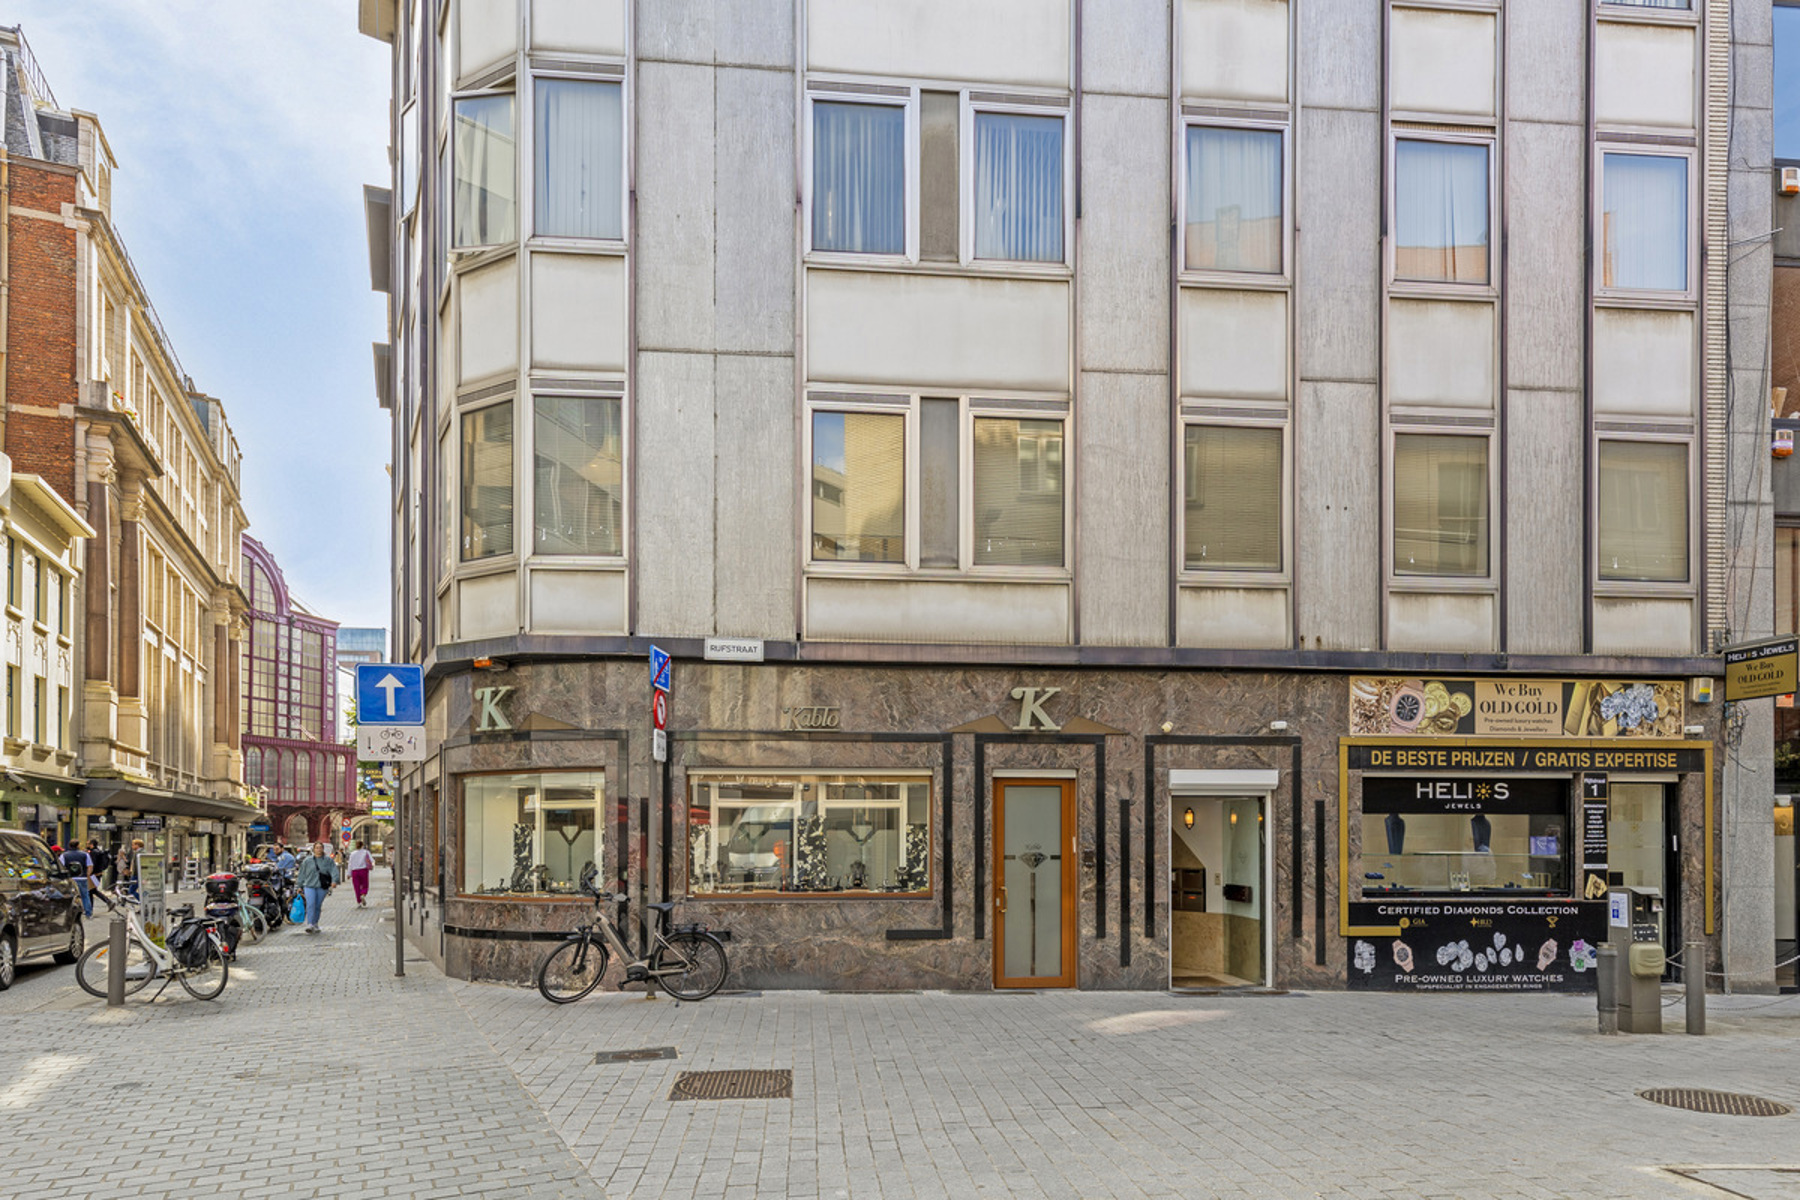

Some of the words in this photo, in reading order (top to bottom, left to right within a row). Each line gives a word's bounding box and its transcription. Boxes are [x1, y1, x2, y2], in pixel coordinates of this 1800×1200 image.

[1737, 674, 1756, 684] OLD
[1757, 670, 1784, 681] GOLD
[1494, 683, 1516, 696] We
[1519, 683, 1544, 700] Buy
[474, 685, 515, 731] K
[1011, 687, 1061, 730] K
[1480, 701, 1512, 714] OLD
[1514, 701, 1558, 714] GOLD
[782, 706, 841, 731] Kablo
[1371, 750, 1392, 765] DE
[1396, 750, 1447, 766] BESTE
[1451, 751, 1515, 766] PRIJZEN
[1535, 752, 1591, 767] GRATIS
[1595, 752, 1678, 768] EXPERTISE
[1591, 784, 1598, 796] 1
[1378, 905, 1440, 915] CERTIFIED
[1443, 905, 1504, 915] DIAMONDS
[1506, 905, 1579, 914] COLLECTION
[1395, 975, 1463, 983] PRE-OWNED
[1466, 974, 1509, 983] LUXURY
[1512, 974, 1564, 982] WATCHES
